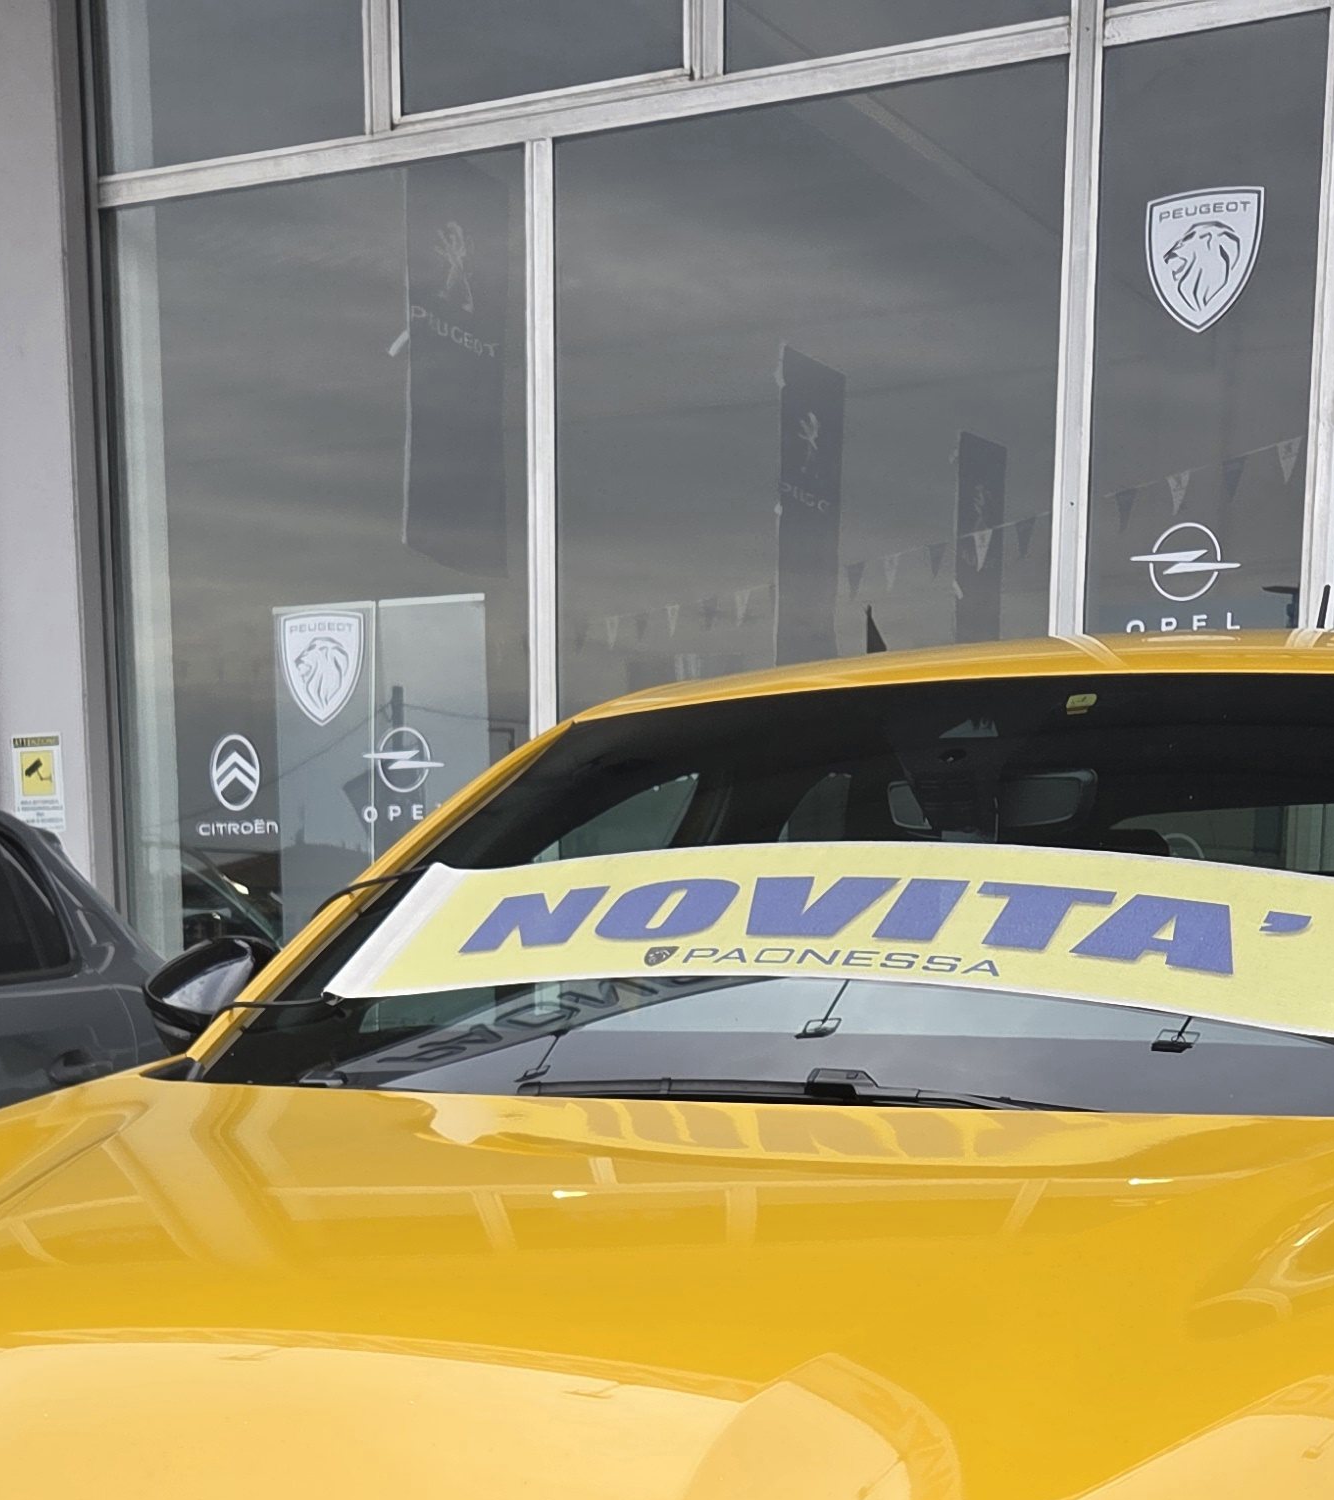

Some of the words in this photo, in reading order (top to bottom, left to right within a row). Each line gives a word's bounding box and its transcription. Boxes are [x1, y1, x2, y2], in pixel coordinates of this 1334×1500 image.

[1158, 199, 1252, 223] PEUGEOT
[289, 620, 355, 635] PEUGEOT
[363, 803, 443, 824] OPE
[459, 874, 1314, 977] NOVITA'
[682, 945, 1001, 979] PAONESSA
